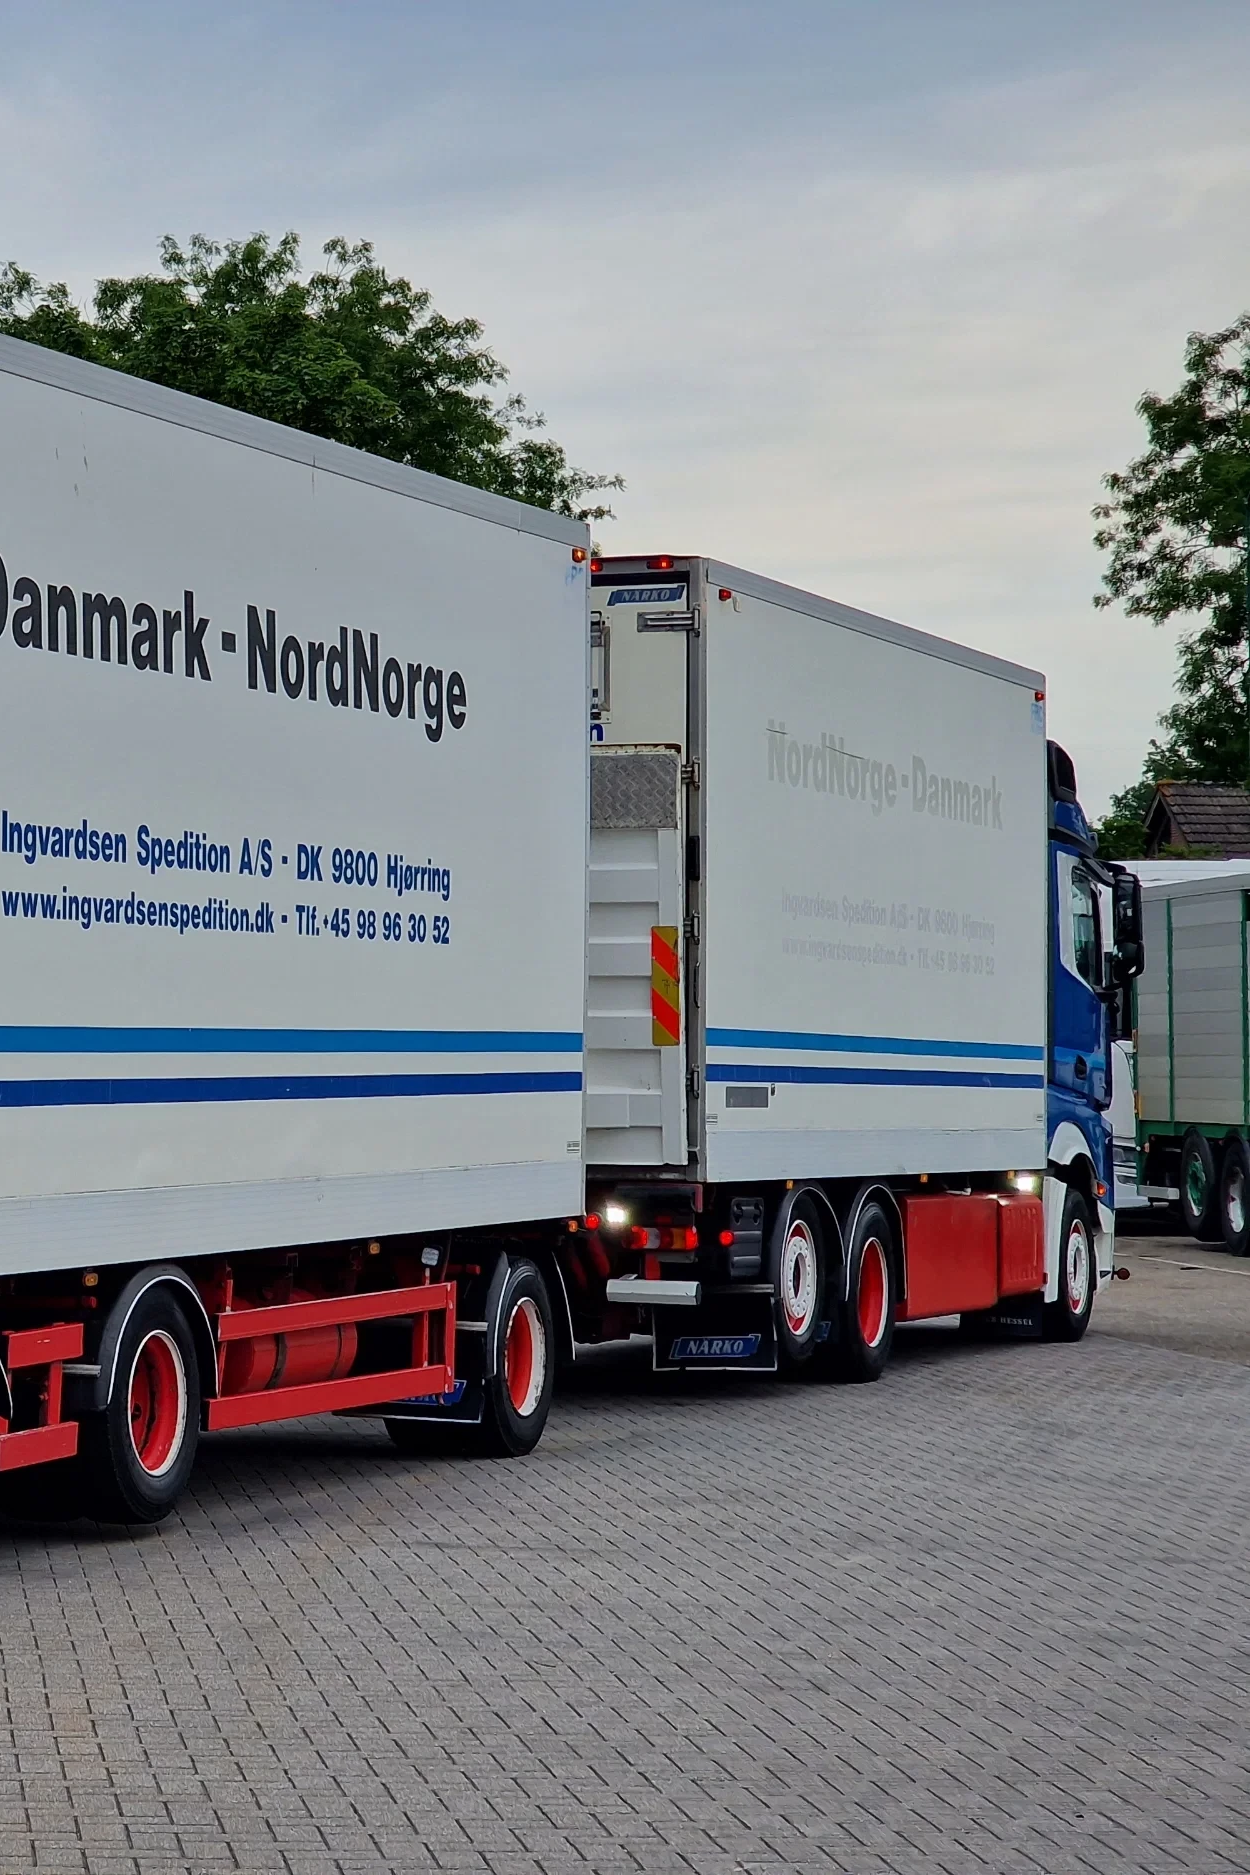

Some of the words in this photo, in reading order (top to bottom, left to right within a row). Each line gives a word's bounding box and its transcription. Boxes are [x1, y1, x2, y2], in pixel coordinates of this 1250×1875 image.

[247, 604, 468, 743] NordNorge
[766, 719, 897, 817] NordNorge
[912, 754, 1002, 831] Danmark
[1, 810, 127, 864] Ingvardsen
[137, 824, 231, 874] Spedition
[239, 838, 273, 878] A/S
[297, 844, 323, 882] DK
[331, 847, 378, 887] 9800
[386, 853, 451, 901] Hjørring
[1, 886, 275, 935] www.ingvardsenspedition.dk
[357, 909, 377, 940] 98
[382, 911, 402, 941] 96
[408, 913, 427, 943] 30
[432, 915, 451, 945] 52
